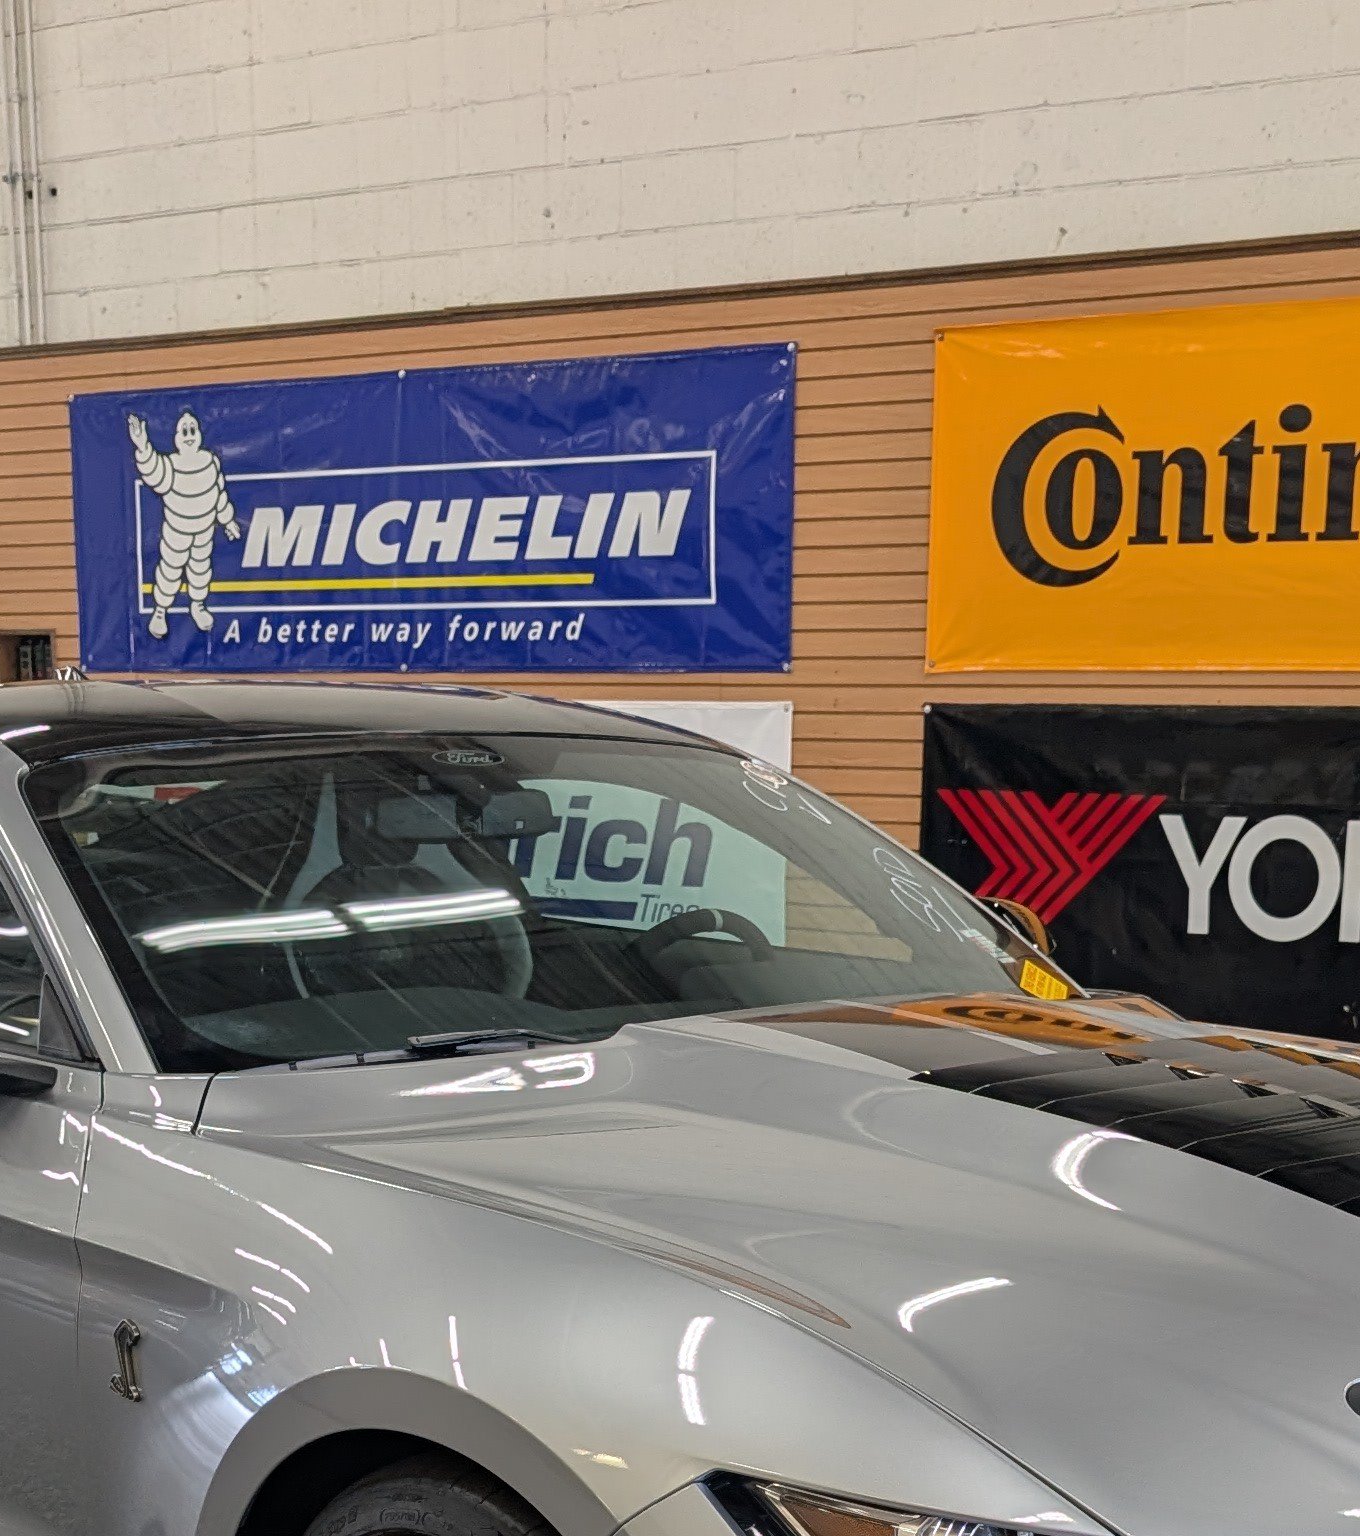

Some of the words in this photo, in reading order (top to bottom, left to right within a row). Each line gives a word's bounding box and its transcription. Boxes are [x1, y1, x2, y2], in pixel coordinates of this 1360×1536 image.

[240, 488, 692, 569] MICHELIN
[222, 619, 241, 643] A
[256, 617, 356, 643] better
[370, 620, 433, 649] way
[446, 613, 586, 643] forward
[513, 795, 713, 888] rich
